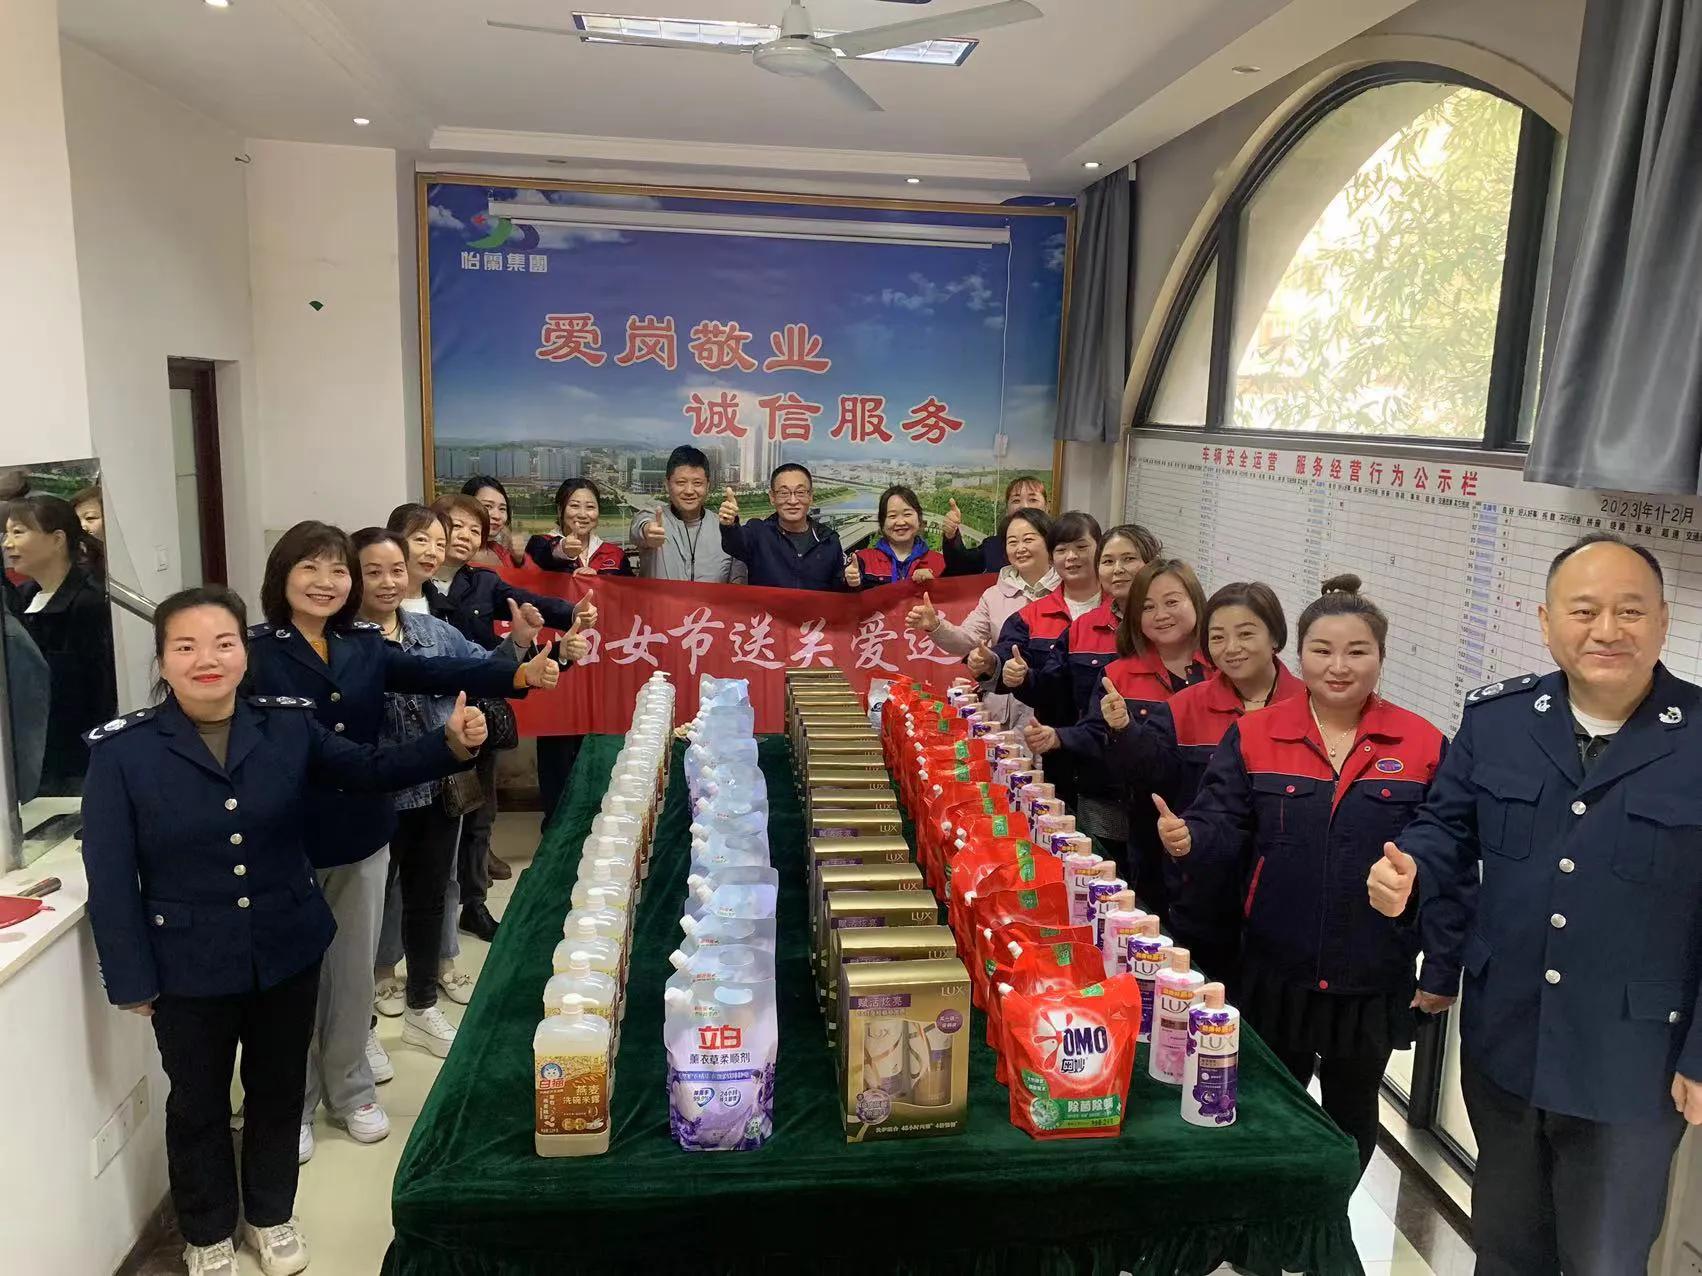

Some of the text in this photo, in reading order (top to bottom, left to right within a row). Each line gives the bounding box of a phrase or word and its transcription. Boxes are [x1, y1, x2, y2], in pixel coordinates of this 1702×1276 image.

[536, 313, 831, 374] 爱岗敬业
[683, 391, 965, 444] 诚信服务
[1202, 446, 1278, 472] 车辆安全运营
[1295, 455, 1478, 497] 服务经营行为公示栏
[880, 824, 897, 832] LUX
[886, 853, 904, 861] LUX
[898, 882, 918, 890] LUX
[911, 912, 933, 921] LUX
[928, 950, 949, 959] LUX
[941, 986, 964, 996] LUX
[1161, 997, 1191, 1014] LUX
[698, 1024, 742, 1050] 立白
[1063, 1026, 1109, 1056] OMO
[1200, 1036, 1235, 1051] LUX
[1061, 1058, 1086, 1074] 奥妙
